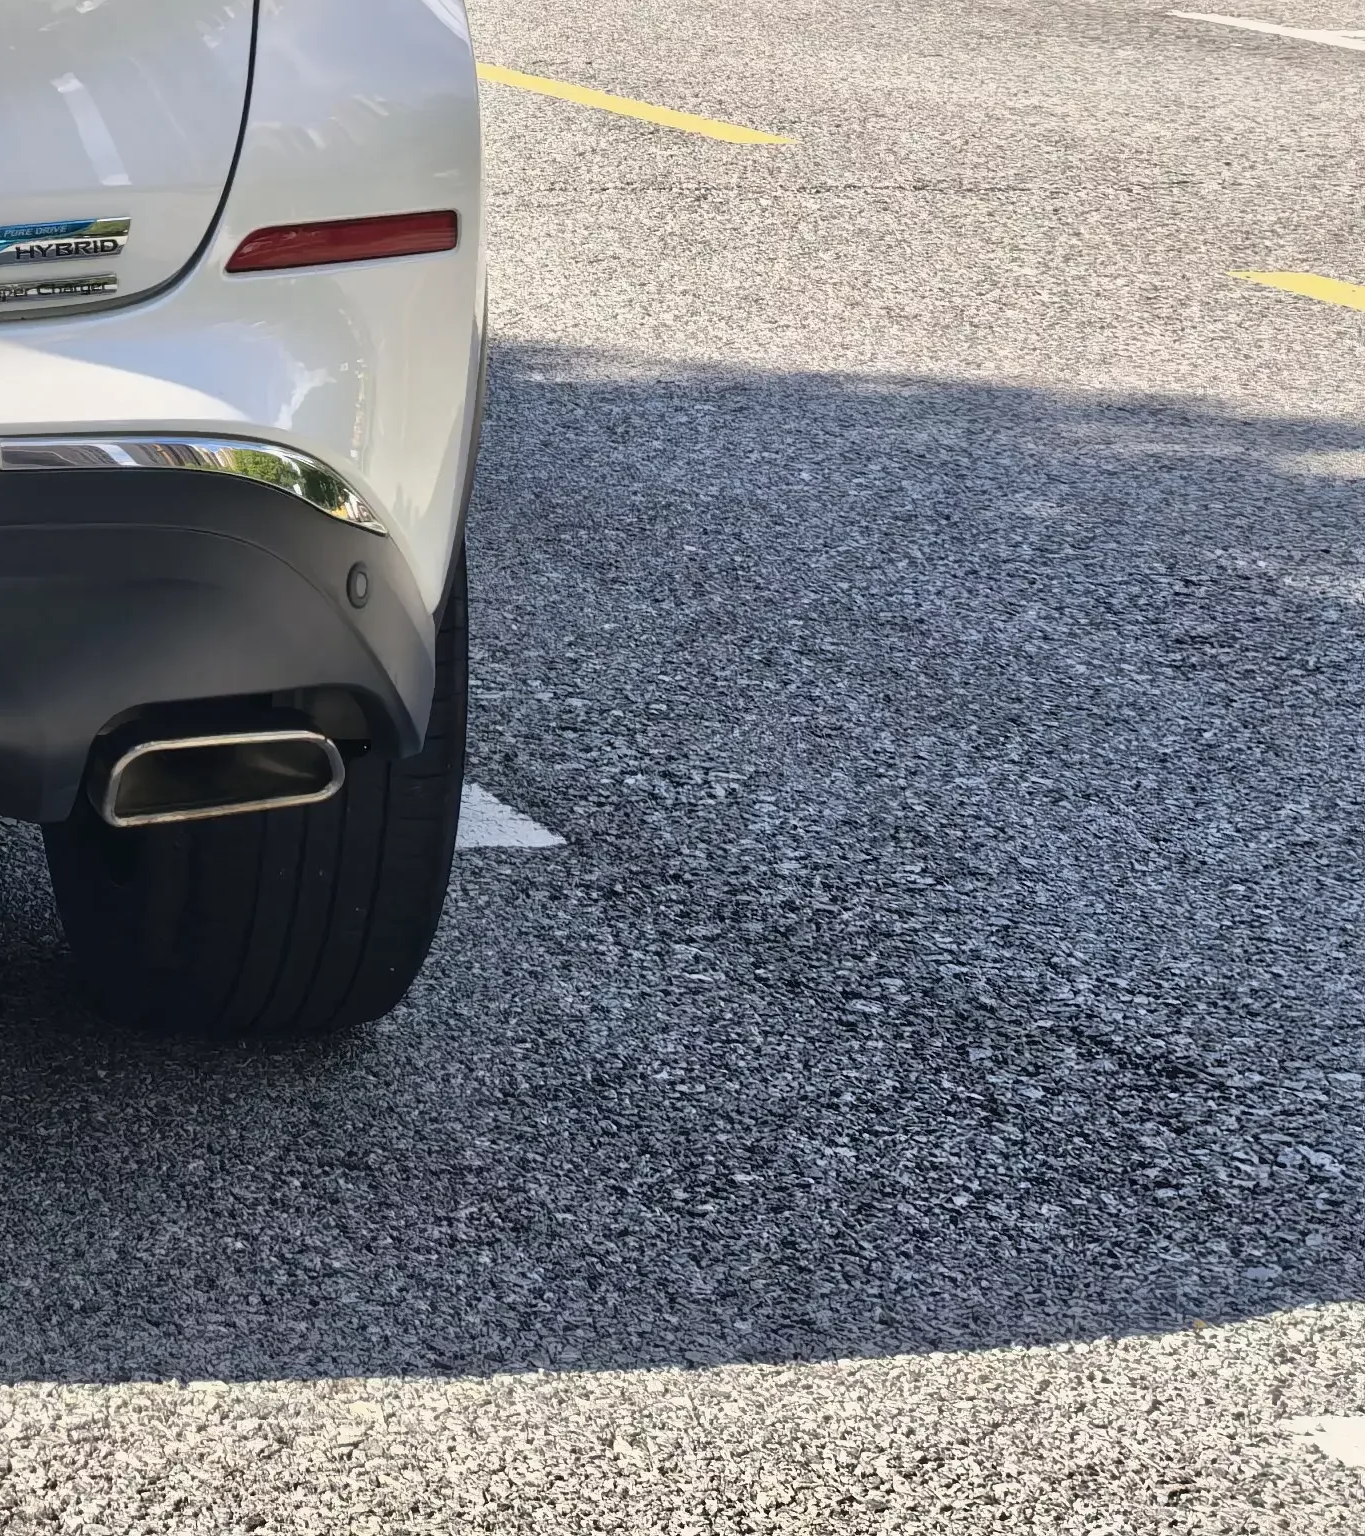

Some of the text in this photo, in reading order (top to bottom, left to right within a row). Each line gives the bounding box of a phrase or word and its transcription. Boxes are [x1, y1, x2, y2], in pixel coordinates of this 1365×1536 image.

[3, 224, 68, 238] PURE DRIVE
[15, 239, 119, 260] HYBRID
